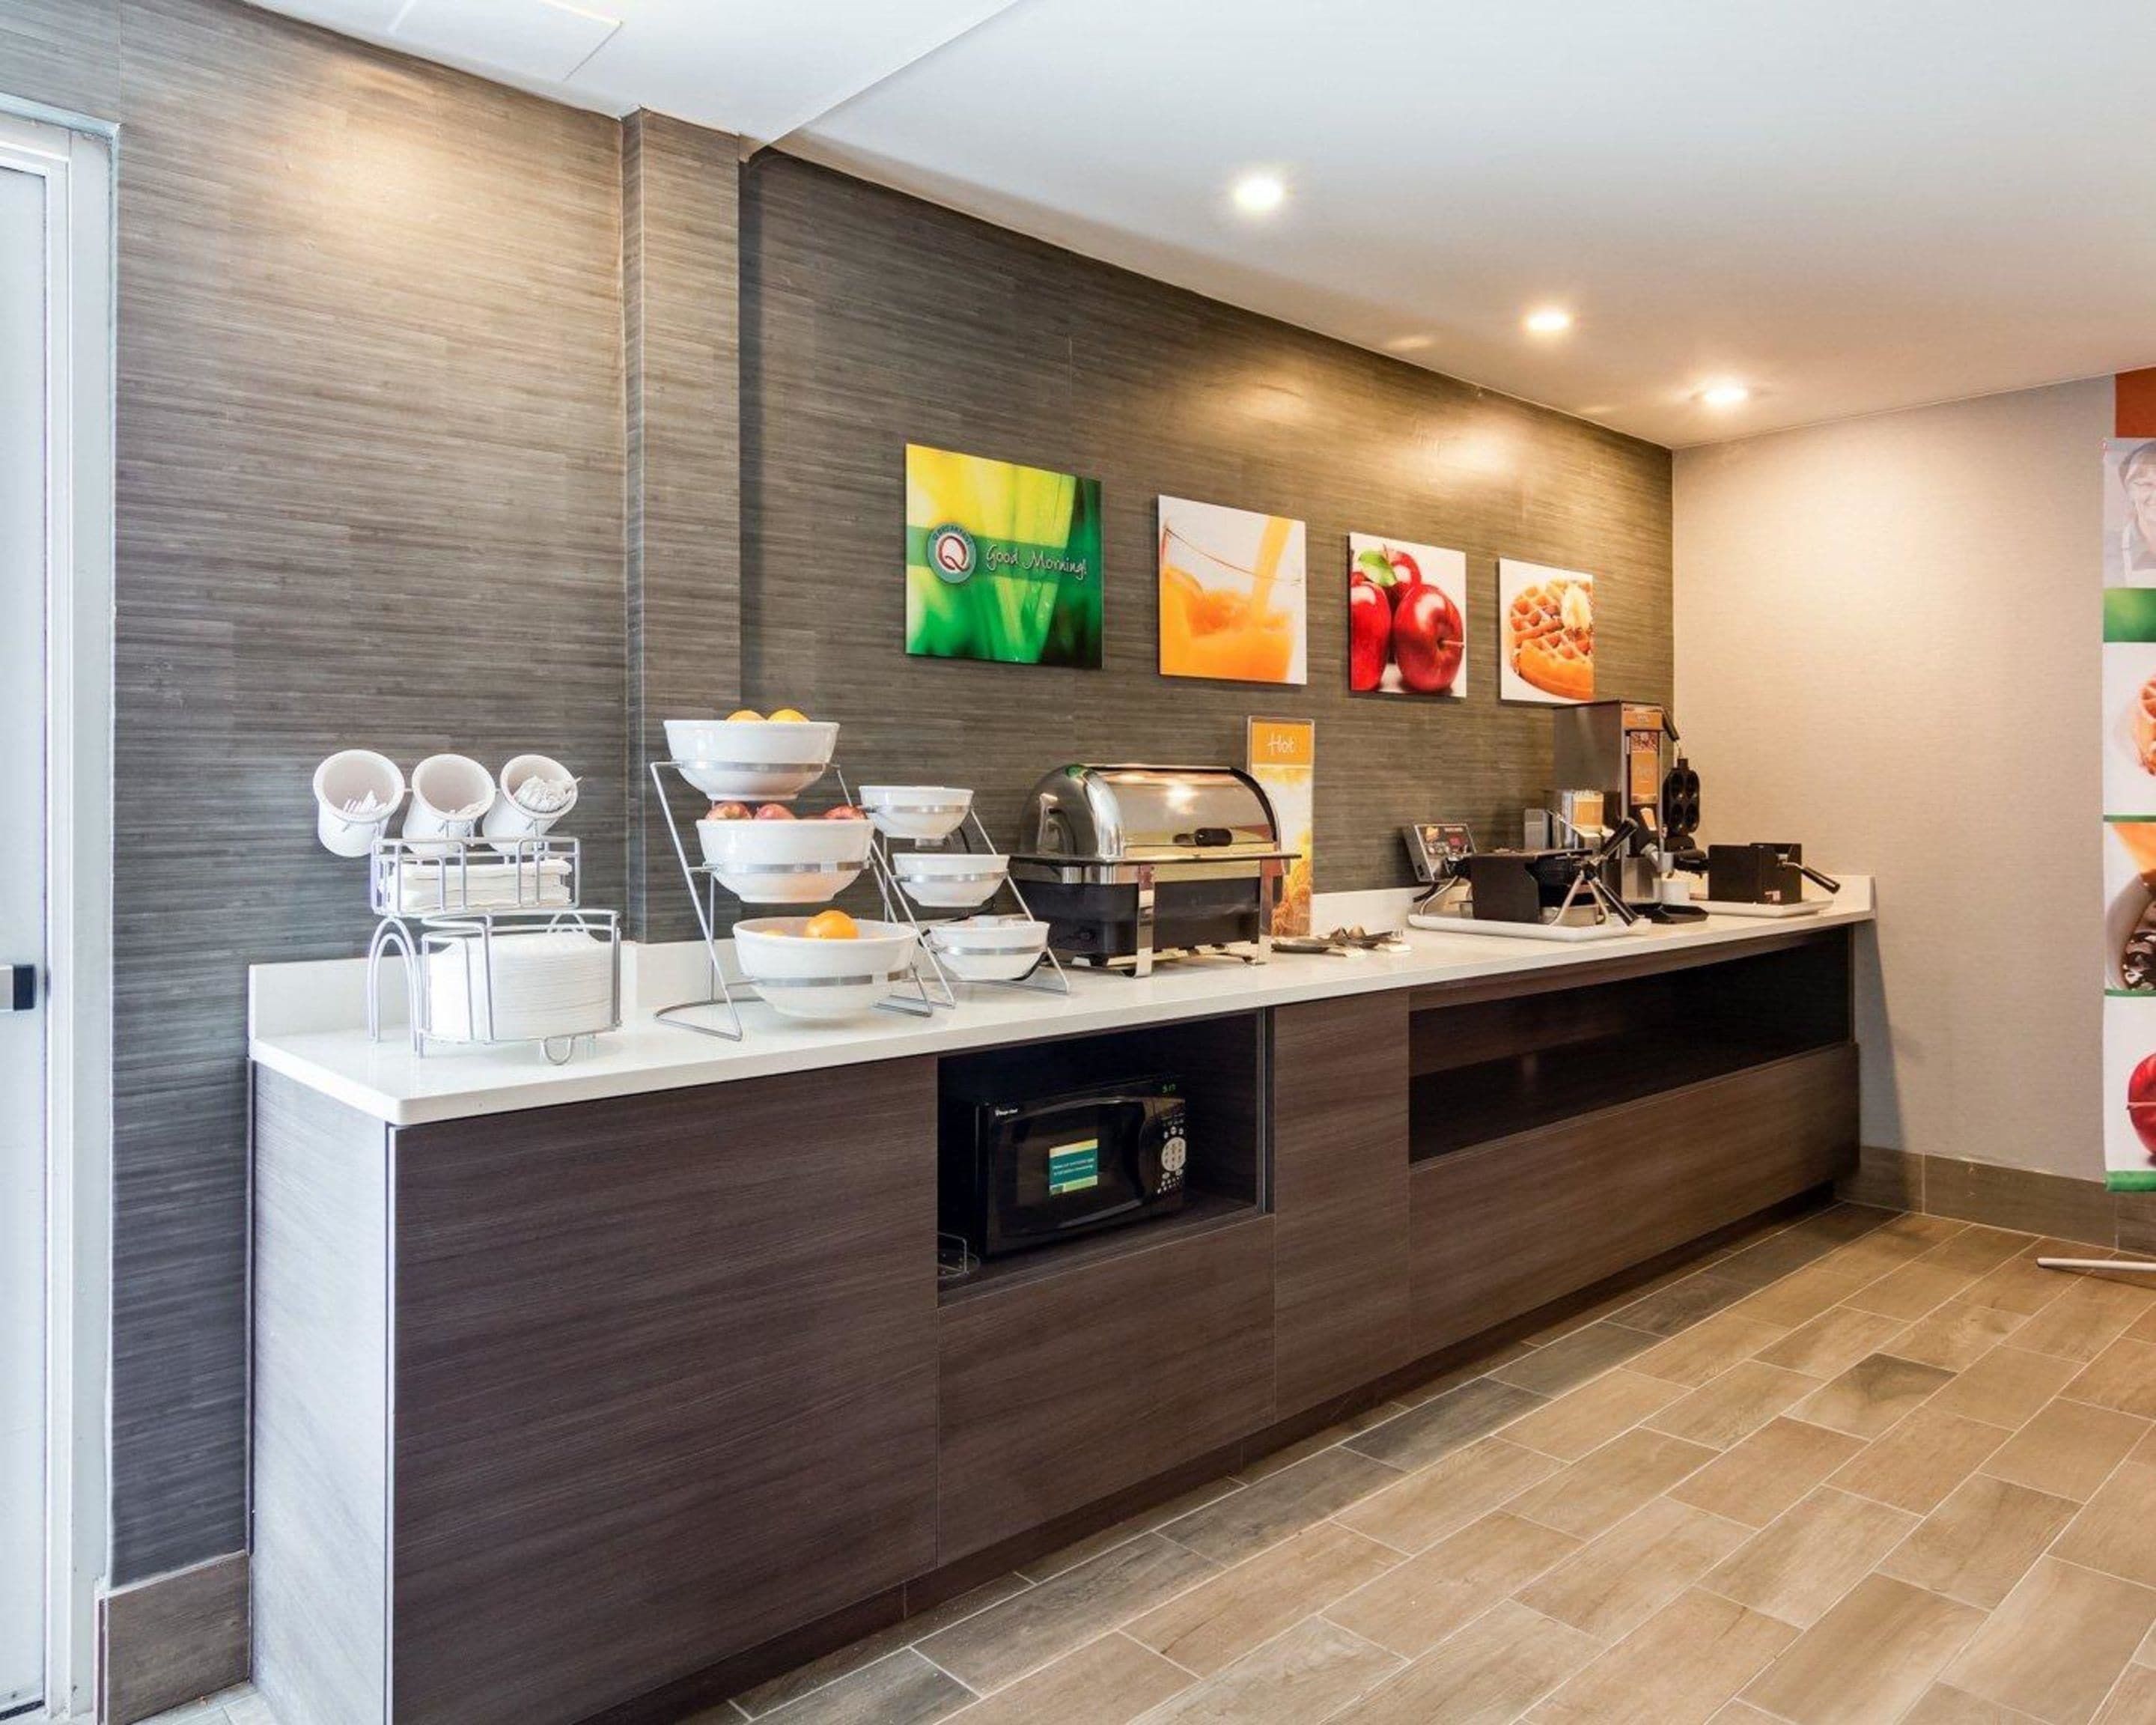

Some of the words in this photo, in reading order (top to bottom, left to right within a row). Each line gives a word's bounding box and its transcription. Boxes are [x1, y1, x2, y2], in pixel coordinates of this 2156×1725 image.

[938, 535, 971, 572] Q
[987, 544, 1018, 571] Good
[1021, 550, 1087, 581] Morning!
[1267, 733, 1294, 755] Hot
